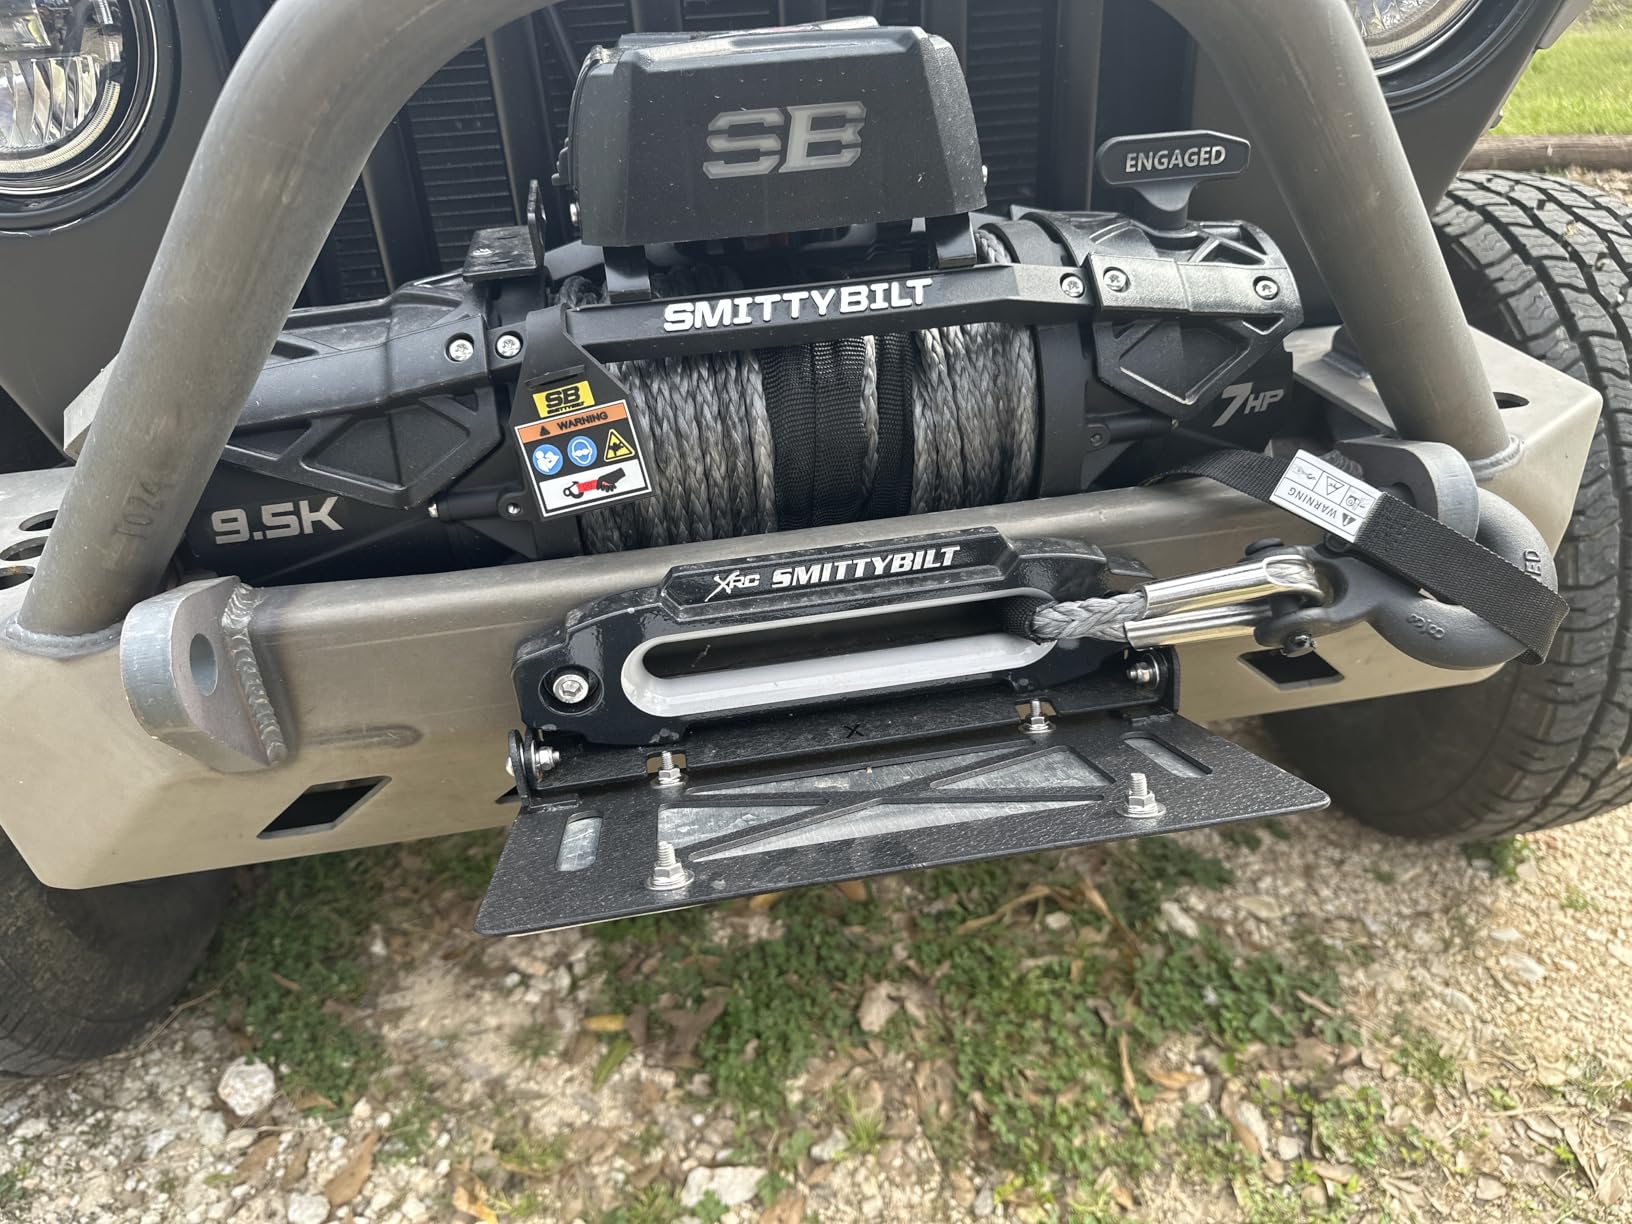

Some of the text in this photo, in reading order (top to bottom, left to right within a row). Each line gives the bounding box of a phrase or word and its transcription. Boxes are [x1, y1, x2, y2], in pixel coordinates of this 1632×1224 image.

[702, 101, 867, 179] SB
[1125, 145, 1226, 173] ENGAGED
[664, 278, 932, 332] SMITTYBILT
[545, 386, 580, 408] SB
[557, 411, 608, 431] WARNING
[211, 496, 344, 544] 9.5K
[1288, 487, 1337, 519] WARNING
[704, 545, 960, 602] XRC SMITTYBILT
